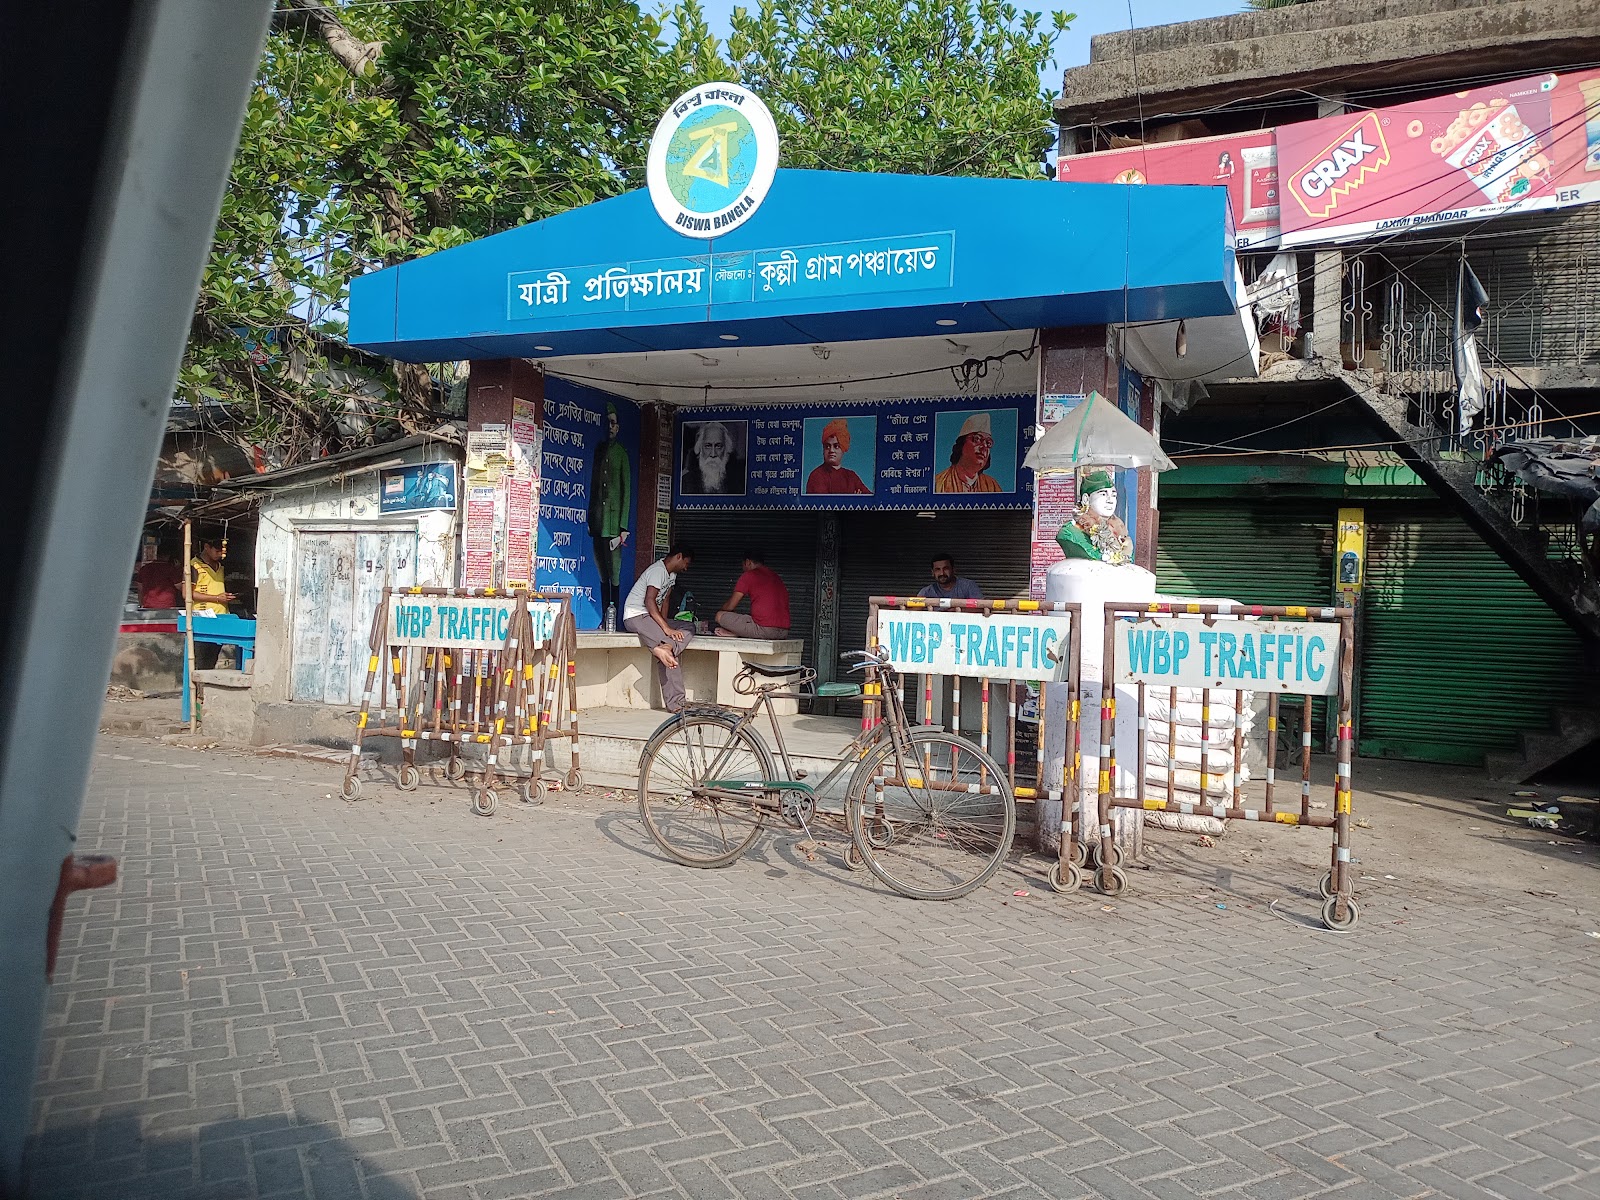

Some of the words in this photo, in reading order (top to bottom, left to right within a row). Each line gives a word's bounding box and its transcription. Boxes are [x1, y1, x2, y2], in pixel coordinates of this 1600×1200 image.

[1509, 88, 1538, 98] NAMKEEN
[673, 92, 702, 119] বিশ্ব
[704, 89, 746, 106] বাংলা
[1464, 134, 1494, 167] CRAX
[1300, 127, 1379, 198] CRAX
[675, 212, 711, 231] BISWA
[714, 195, 755, 229] BANGLA
[1375, 217, 1410, 230] LAXMI
[1412, 210, 1468, 226] BHANDAR
[518, 271, 571, 307] যাত্রী
[583, 267, 705, 302] প্রতিক্ষালয়
[758, 250, 800, 293] কুল্পী
[805, 252, 844, 282] গ্রাম
[846, 246, 940, 278] পঞ্চায়েত
[555, 401, 583, 422] প্রগতির
[913, 415, 928, 424] প্রেম
[915, 433, 929, 442] জন
[566, 456, 583, 474] থেকে
[906, 451, 920, 460] জন
[549, 532, 571, 550] প্রয়াস
[366, 560, 373, 573] 9
[397, 558, 407, 570] 10
[395, 605, 432, 638] WBP
[437, 606, 509, 641] TRAFFIC
[889, 622, 943, 663] WBP
[950, 623, 1058, 670] TRAFFIC
[1127, 629, 1190, 675] WBP
[1199, 631, 1325, 682] TRAFFIC
